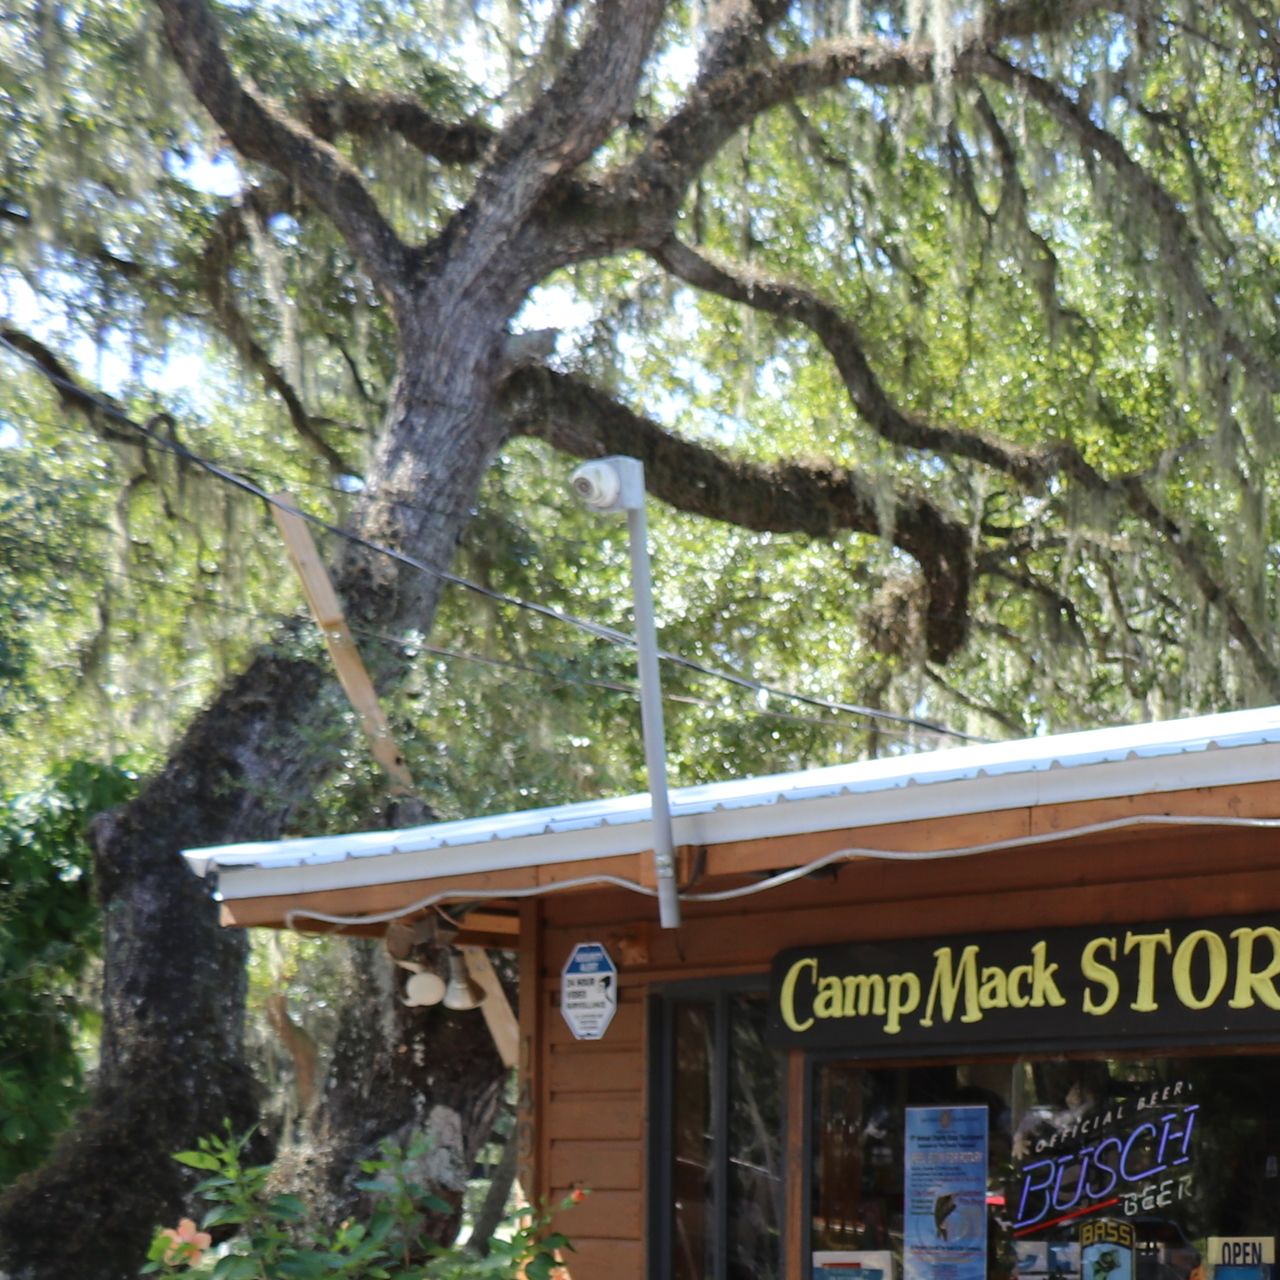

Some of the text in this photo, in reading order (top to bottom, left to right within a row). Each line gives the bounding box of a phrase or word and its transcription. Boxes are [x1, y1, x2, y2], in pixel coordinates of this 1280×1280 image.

[779, 957, 921, 1034] Camp
[919, 939, 1066, 1026] Mack
[1034, 1080, 1184, 1153] OFFICIAL BEER
[1012, 1104, 1200, 1229] BUSCH
[1119, 1175, 1193, 1216] BEER
[1081, 1221, 1132, 1245] BASS
[1221, 1241, 1263, 1265] OPEN
